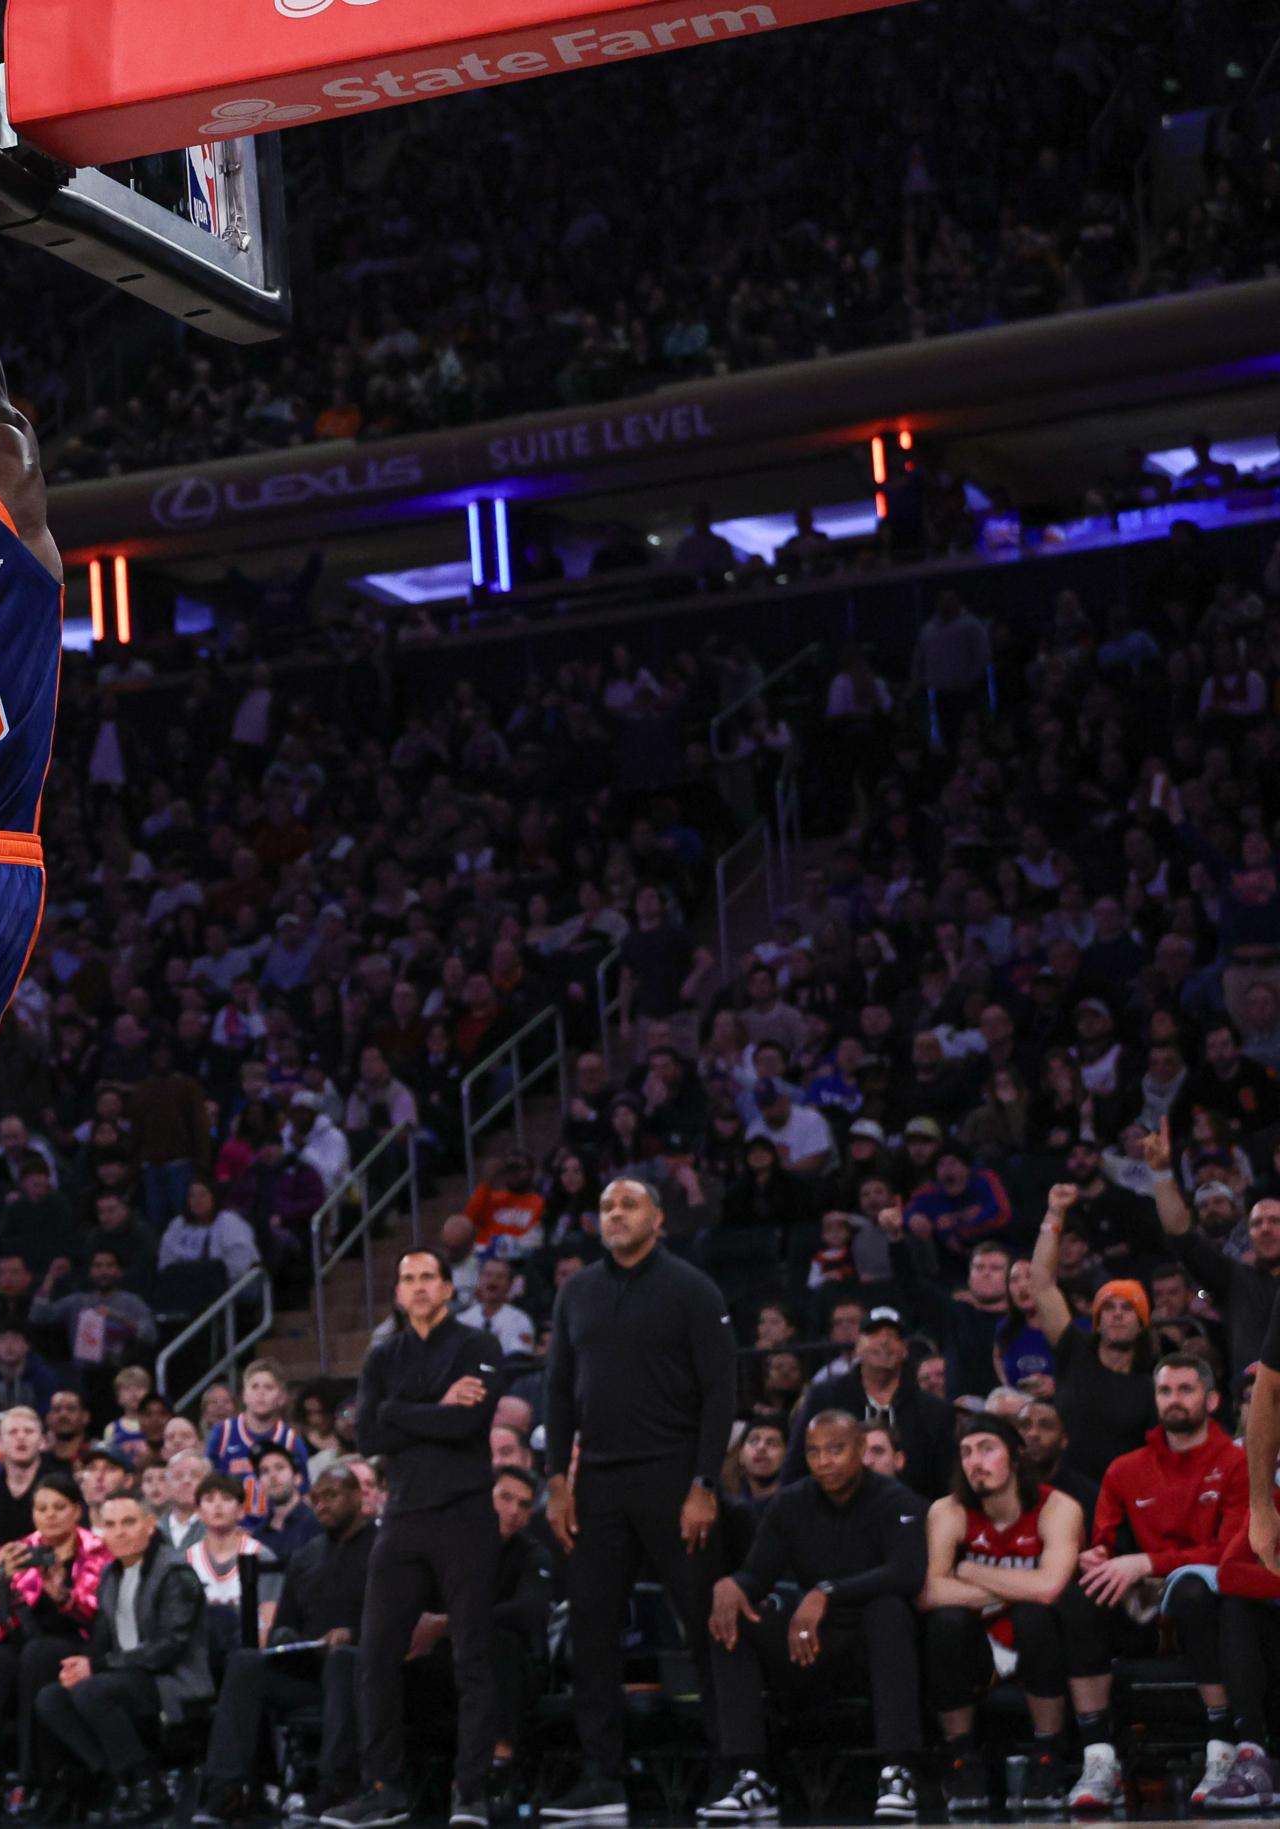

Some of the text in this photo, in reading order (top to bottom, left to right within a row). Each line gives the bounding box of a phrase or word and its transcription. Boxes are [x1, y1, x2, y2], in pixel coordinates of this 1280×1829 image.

[488, 404, 715, 471] SUITE LEVEL
[224, 454, 422, 510] LEXUS
